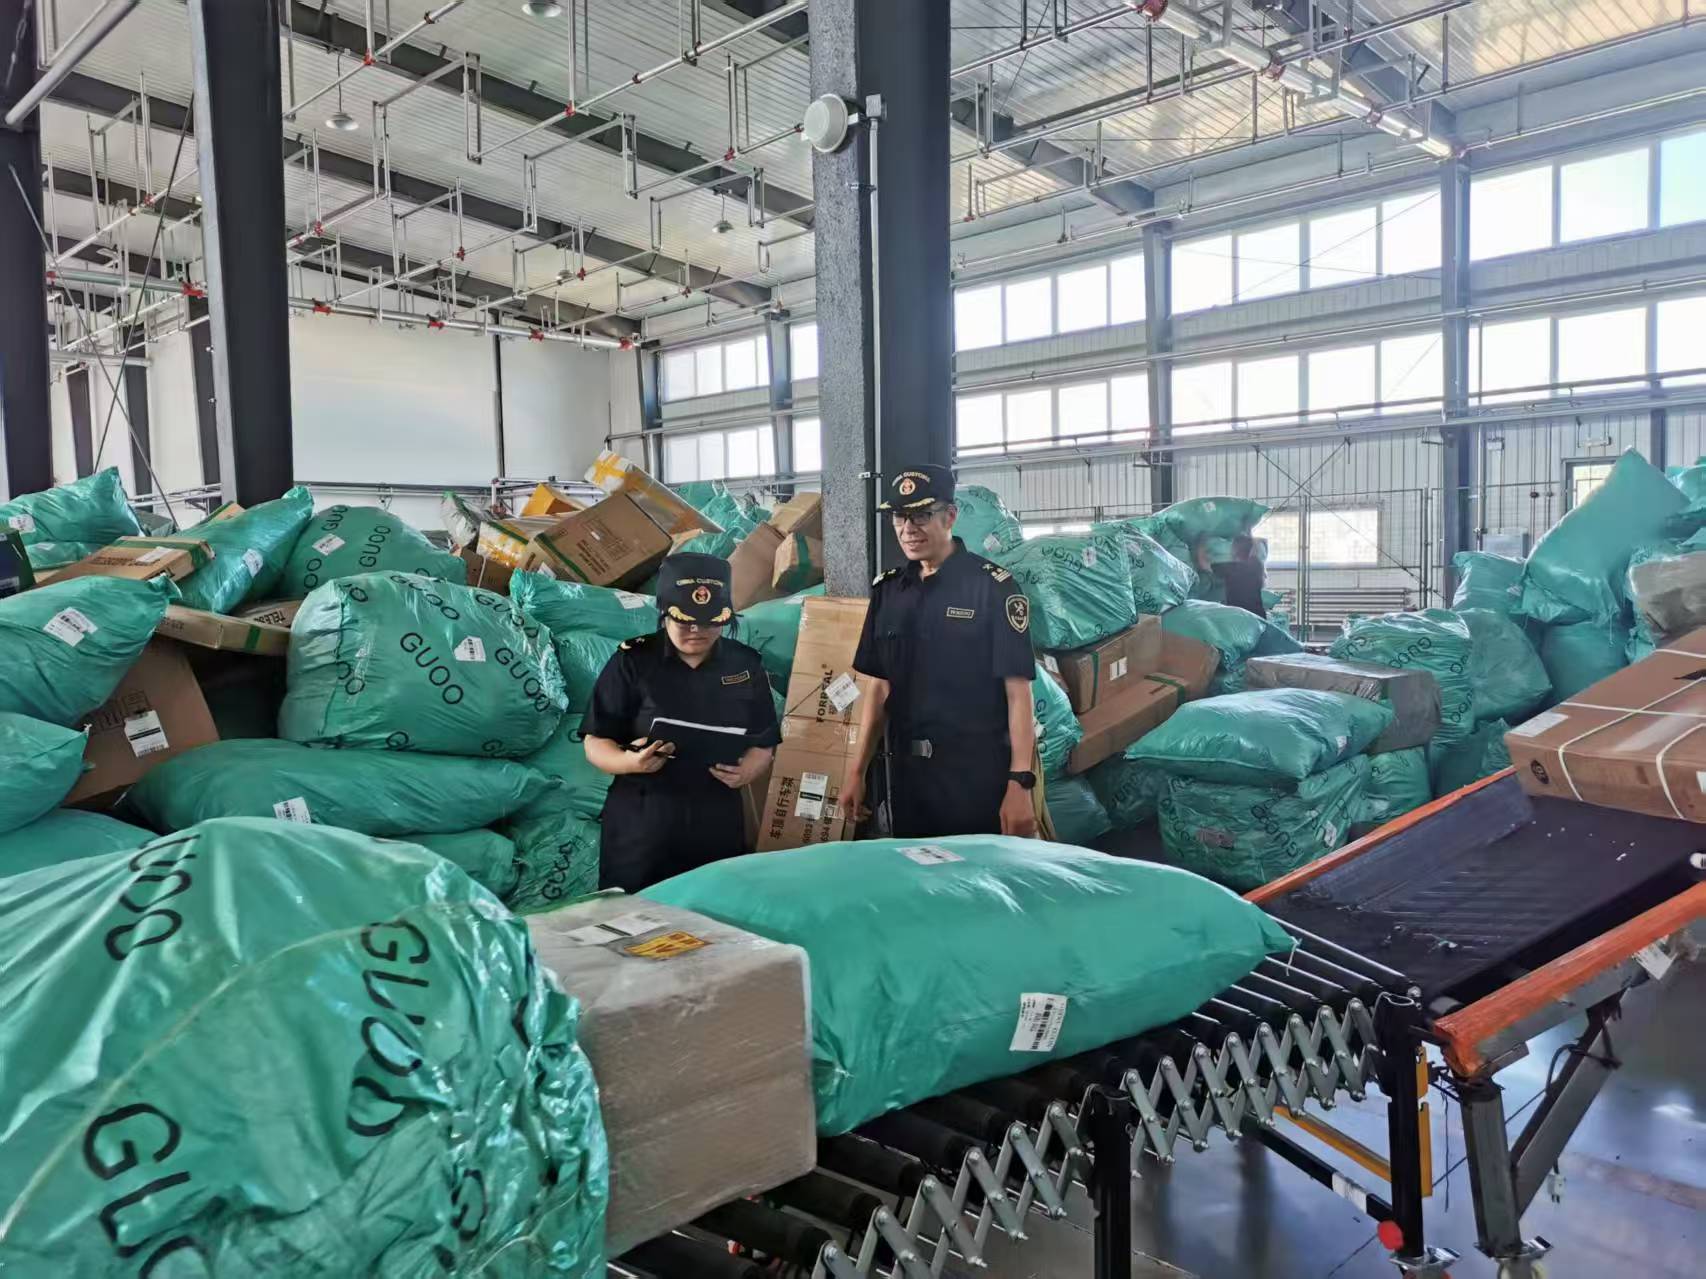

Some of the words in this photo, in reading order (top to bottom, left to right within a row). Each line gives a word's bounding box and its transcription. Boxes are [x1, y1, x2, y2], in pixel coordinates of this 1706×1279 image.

[359, 525, 391, 568] GUOO
[390, 575, 461, 620] GUOO
[400, 632, 464, 705] GUOO
[495, 647, 550, 712] GUOO
